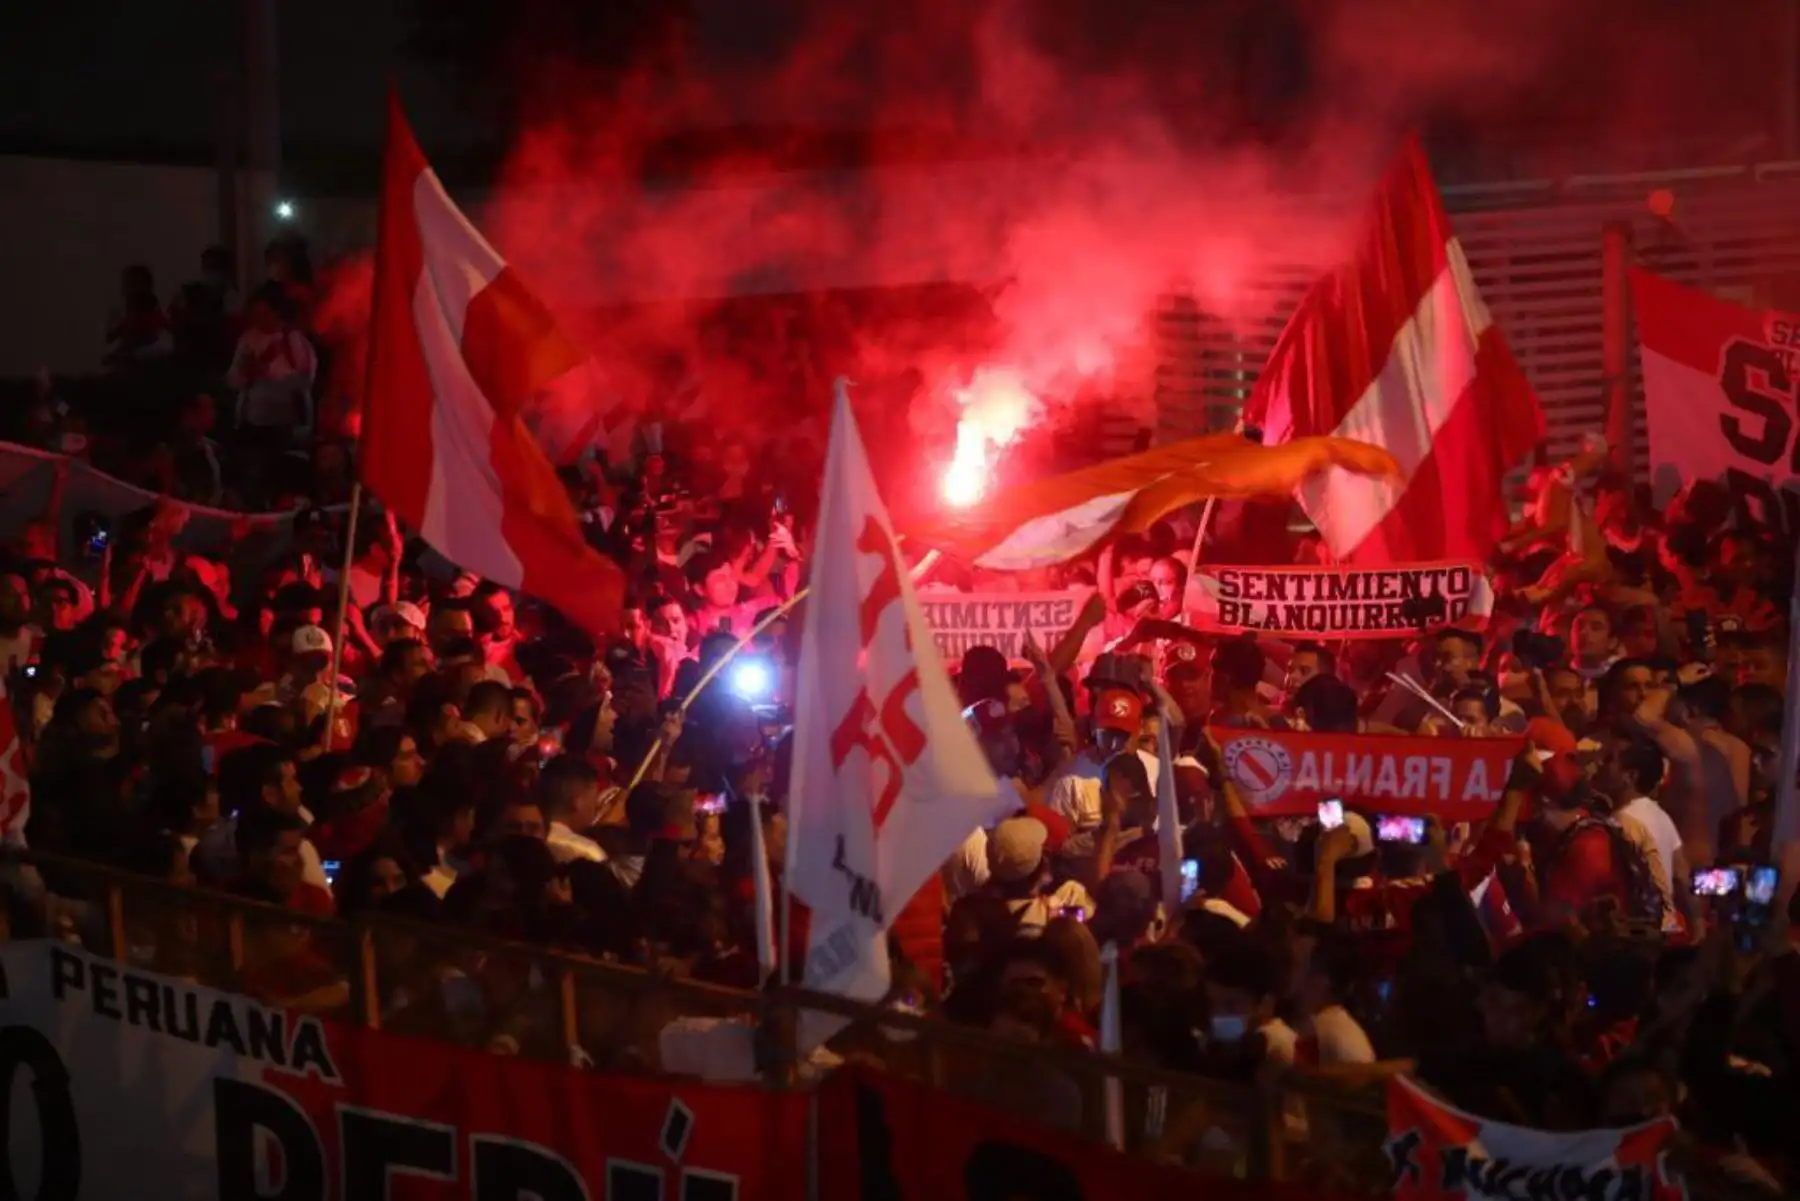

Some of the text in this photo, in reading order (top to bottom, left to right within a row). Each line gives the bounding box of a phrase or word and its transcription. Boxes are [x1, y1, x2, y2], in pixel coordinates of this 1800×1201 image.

[1218, 566, 1471, 601] SENTIMIENTO
[1217, 598, 1468, 633] BLANQUIRRO
[51, 946, 341, 1079] PERUANA
